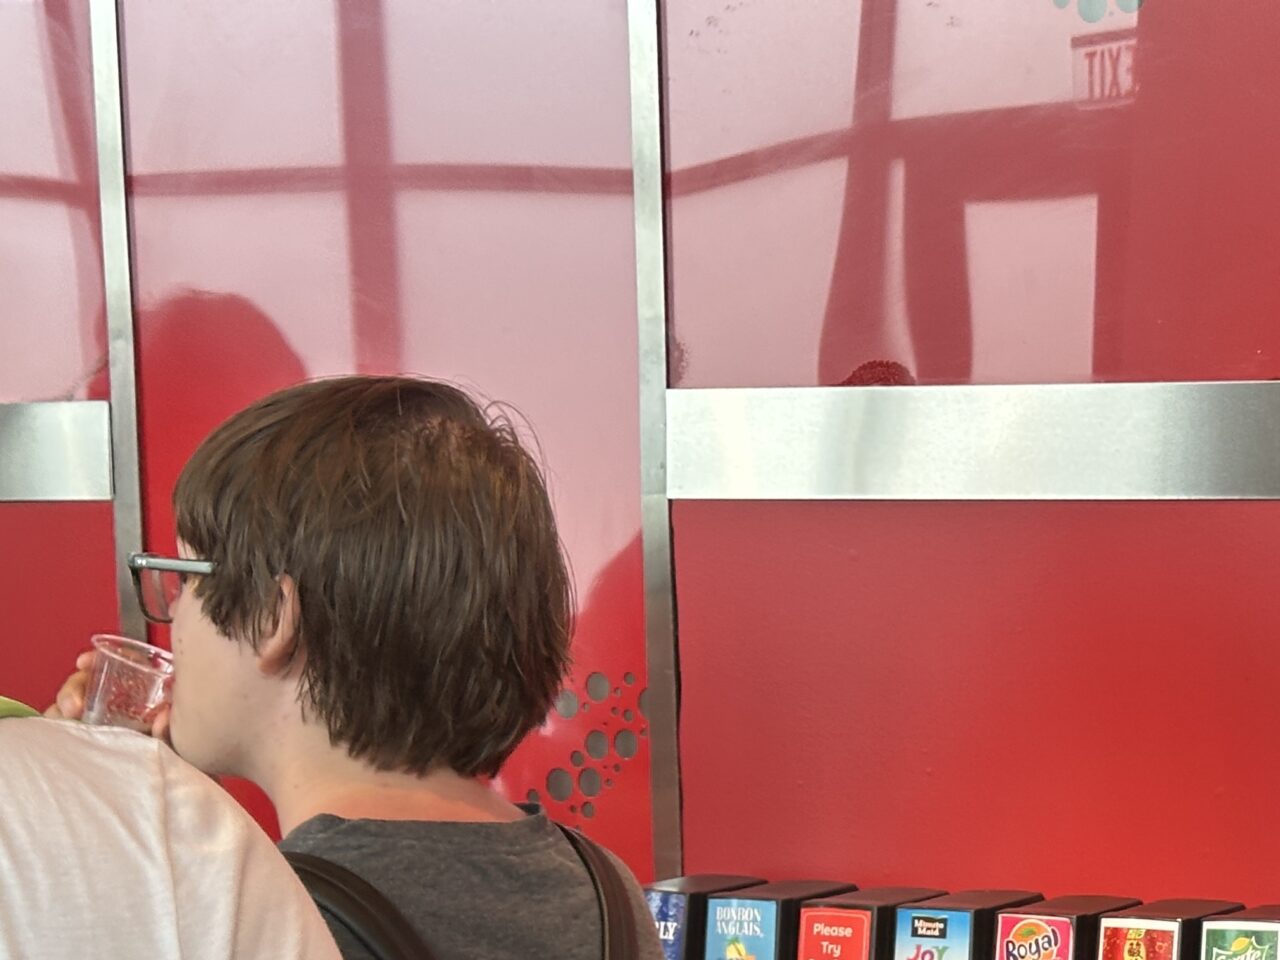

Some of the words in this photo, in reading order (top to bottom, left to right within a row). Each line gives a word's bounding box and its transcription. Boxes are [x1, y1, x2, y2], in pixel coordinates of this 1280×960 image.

[716, 906, 761, 922] BONBON
[655, 921, 678, 940] LY
[716, 921, 762, 936] ANGLAIS
[813, 923, 853, 938] Please
[914, 919, 945, 929] Minute
[917, 927, 940, 936] Maid
[820, 942, 841, 957] Try
